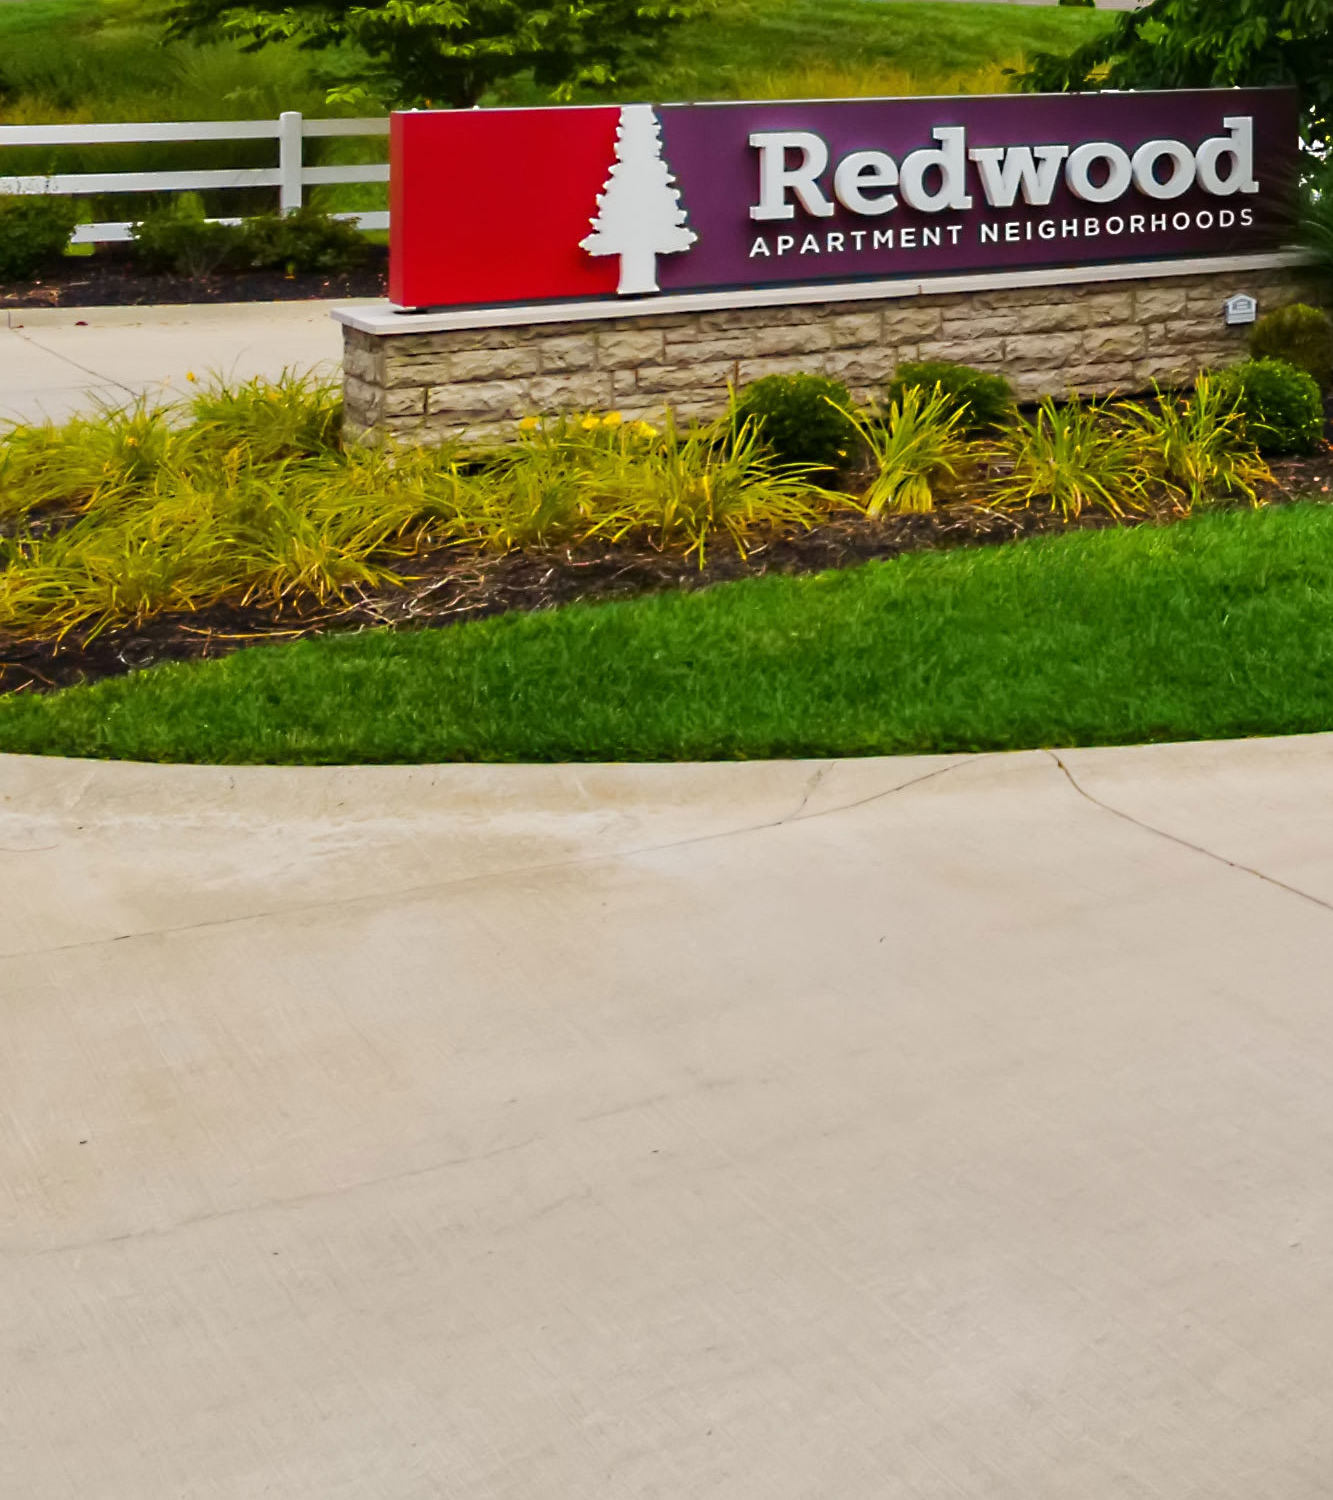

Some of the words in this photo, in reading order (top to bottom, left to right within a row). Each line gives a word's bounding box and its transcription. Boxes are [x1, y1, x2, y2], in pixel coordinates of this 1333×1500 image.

[748, 115, 1260, 221] Redwood
[749, 225, 963, 257] APARTMENT
[981, 208, 1253, 243] NEIGHBORHOODS
